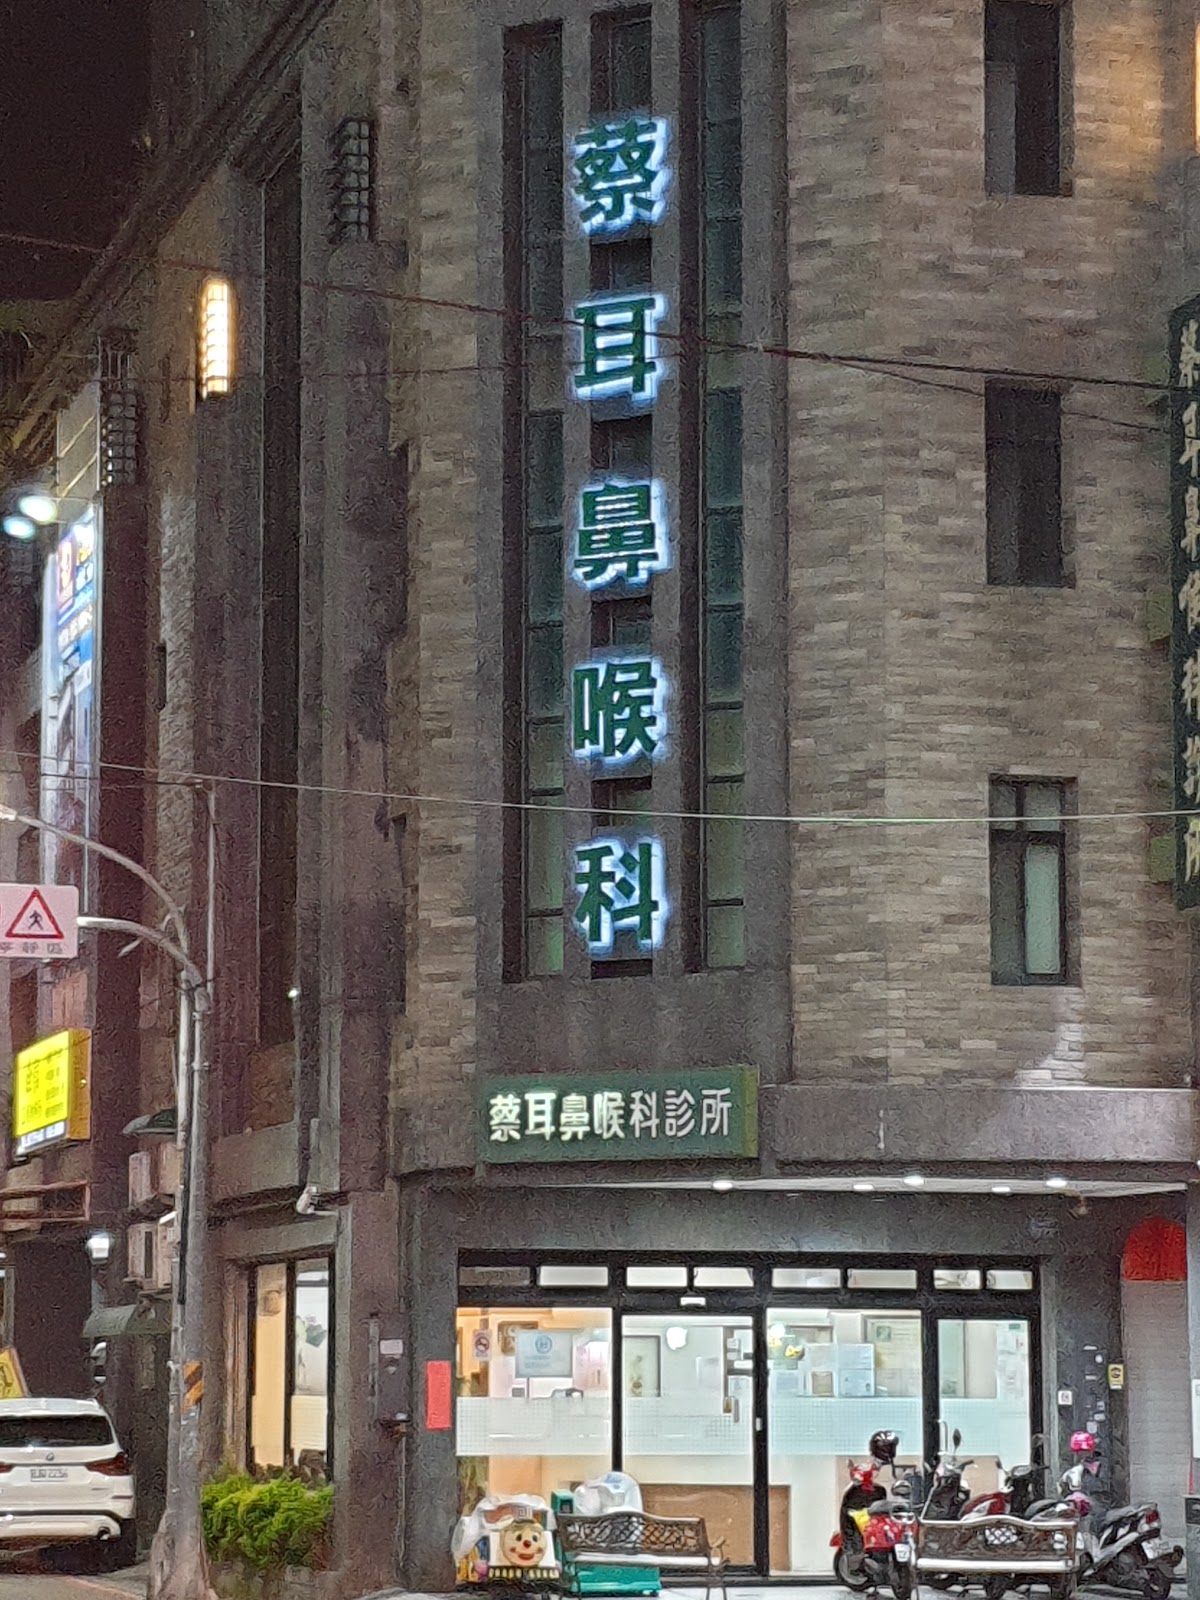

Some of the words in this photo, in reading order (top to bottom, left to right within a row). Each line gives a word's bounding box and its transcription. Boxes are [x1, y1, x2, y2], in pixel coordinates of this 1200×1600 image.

[573, 117, 662, 946] 蔡耳鼻喉科
[488, 1087, 733, 1143] 蔡耳鼻喉科診所
